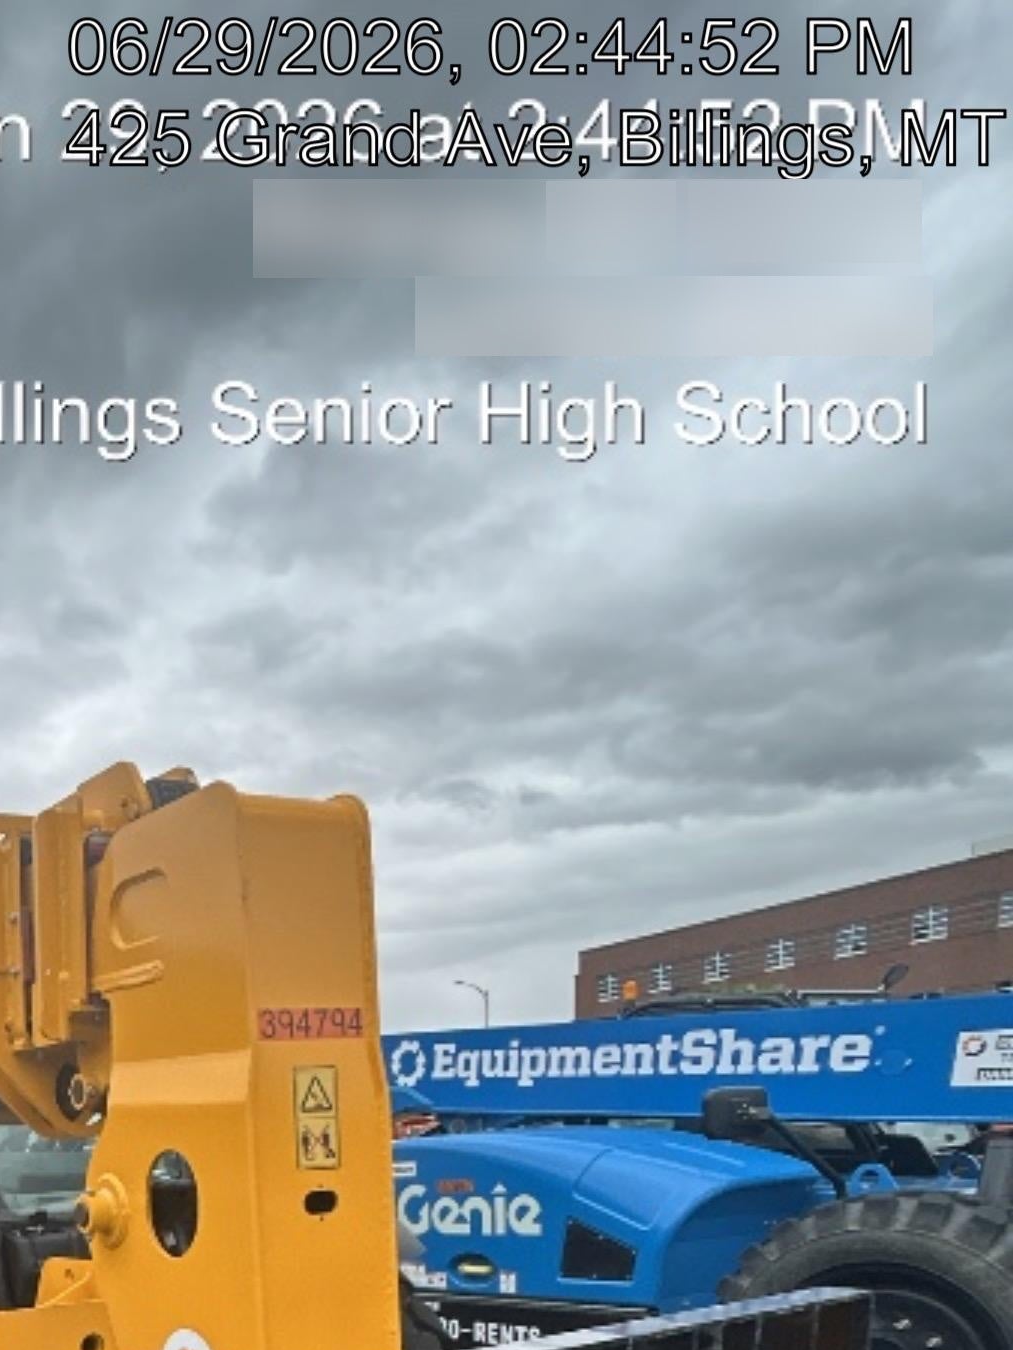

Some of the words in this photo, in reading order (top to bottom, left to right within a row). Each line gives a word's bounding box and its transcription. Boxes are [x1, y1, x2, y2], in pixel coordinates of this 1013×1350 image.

[258, 1008, 363, 1039] 394794
[432, 1028, 874, 1086] EquipmentShare
[398, 1181, 544, 1237] Genie
